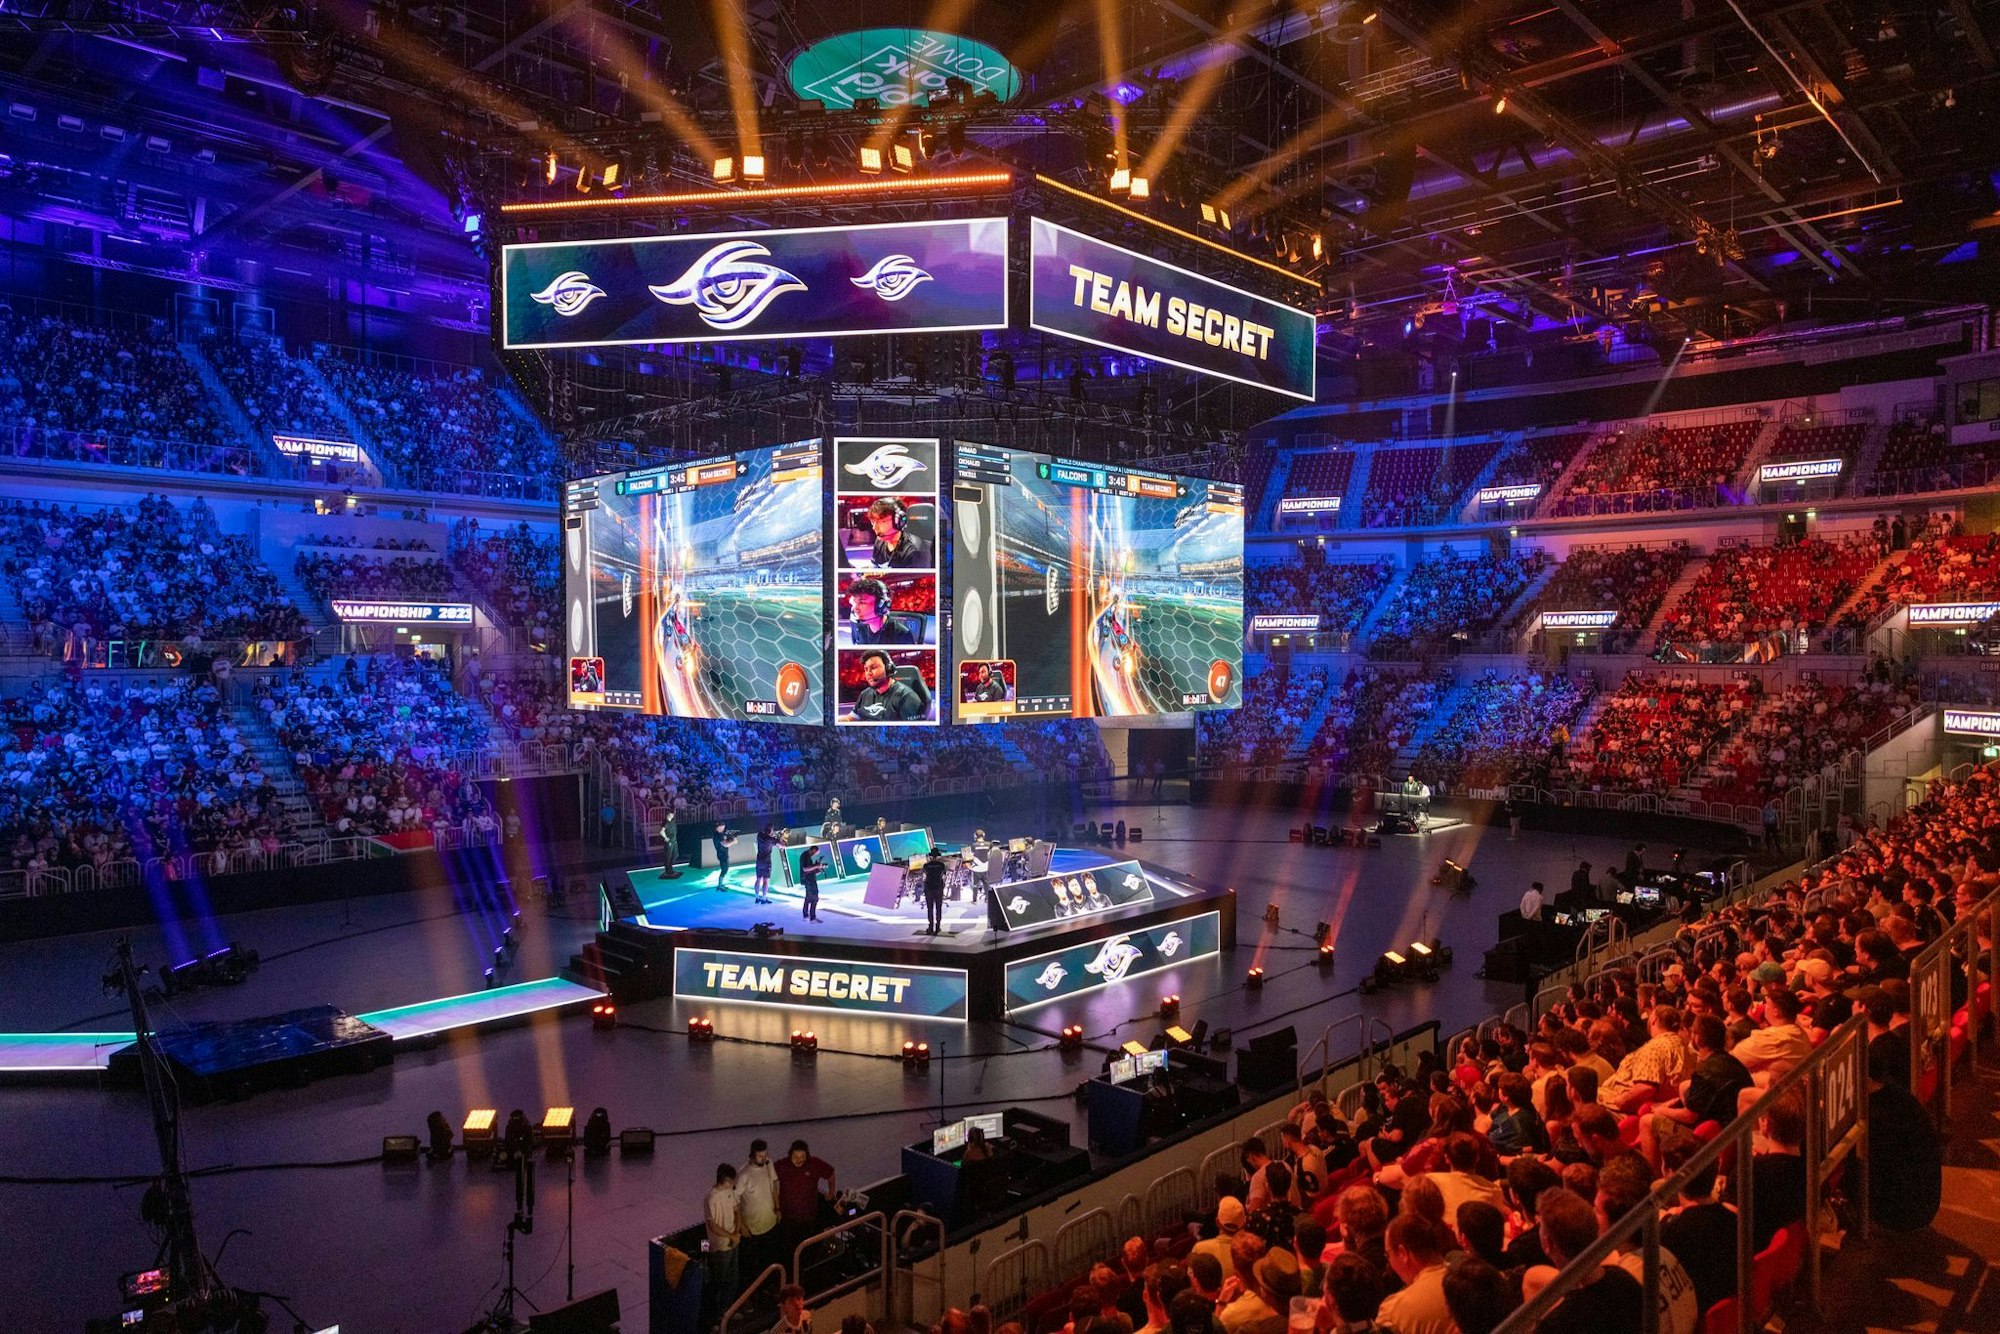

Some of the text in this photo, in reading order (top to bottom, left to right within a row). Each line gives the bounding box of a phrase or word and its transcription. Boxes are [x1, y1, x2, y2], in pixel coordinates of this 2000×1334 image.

[906, 34, 1006, 81] DOME
[875, 54, 949, 89] ank
[1069, 264, 1275, 360] TEAM SECRET
[1073, 460, 1102, 469] CHAMPIONSHIP
[670, 472, 686, 484] 3:45
[700, 468, 731, 479] TEAM SECRET
[1057, 470, 1088, 482] FALCONS
[629, 480, 653, 491] FALCONS
[1108, 475, 1126, 487] 3:45
[1141, 482, 1172, 493] TEAM SECRET
[785, 681, 799, 696] 47
[1215, 677, 1226, 688] 47
[746, 701, 766, 714] Mobil
[1945, 715, 2000, 731] HAMPION
[703, 962, 911, 1003] TEAM SECRET
[1921, 971, 1937, 1016] 023
[1829, 1054, 1853, 1129] 024
